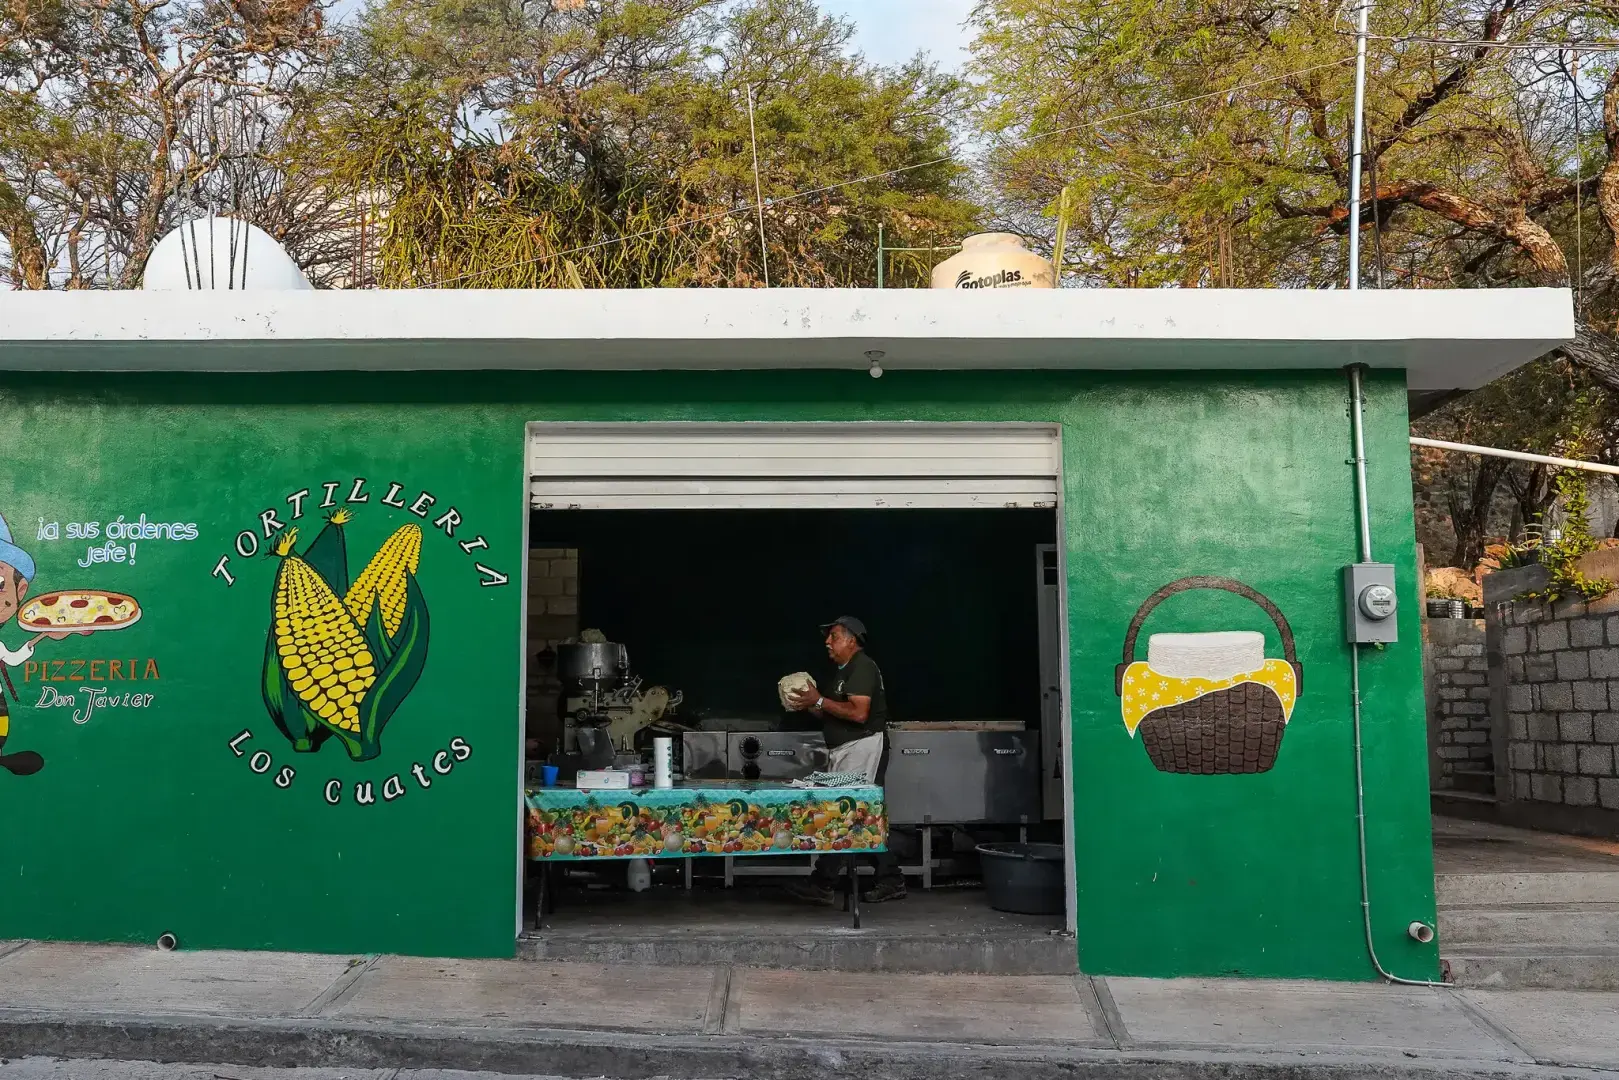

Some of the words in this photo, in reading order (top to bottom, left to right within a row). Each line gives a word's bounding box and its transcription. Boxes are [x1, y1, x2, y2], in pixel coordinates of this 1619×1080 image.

[66, 521, 100, 539] sus
[106, 513, 199, 541] órdenes
[210, 477, 508, 588] TORTILLERIA
[24, 658, 161, 683] PIZZERIA
[35, 685, 75, 709] Don
[72, 686, 154, 725] Javier
